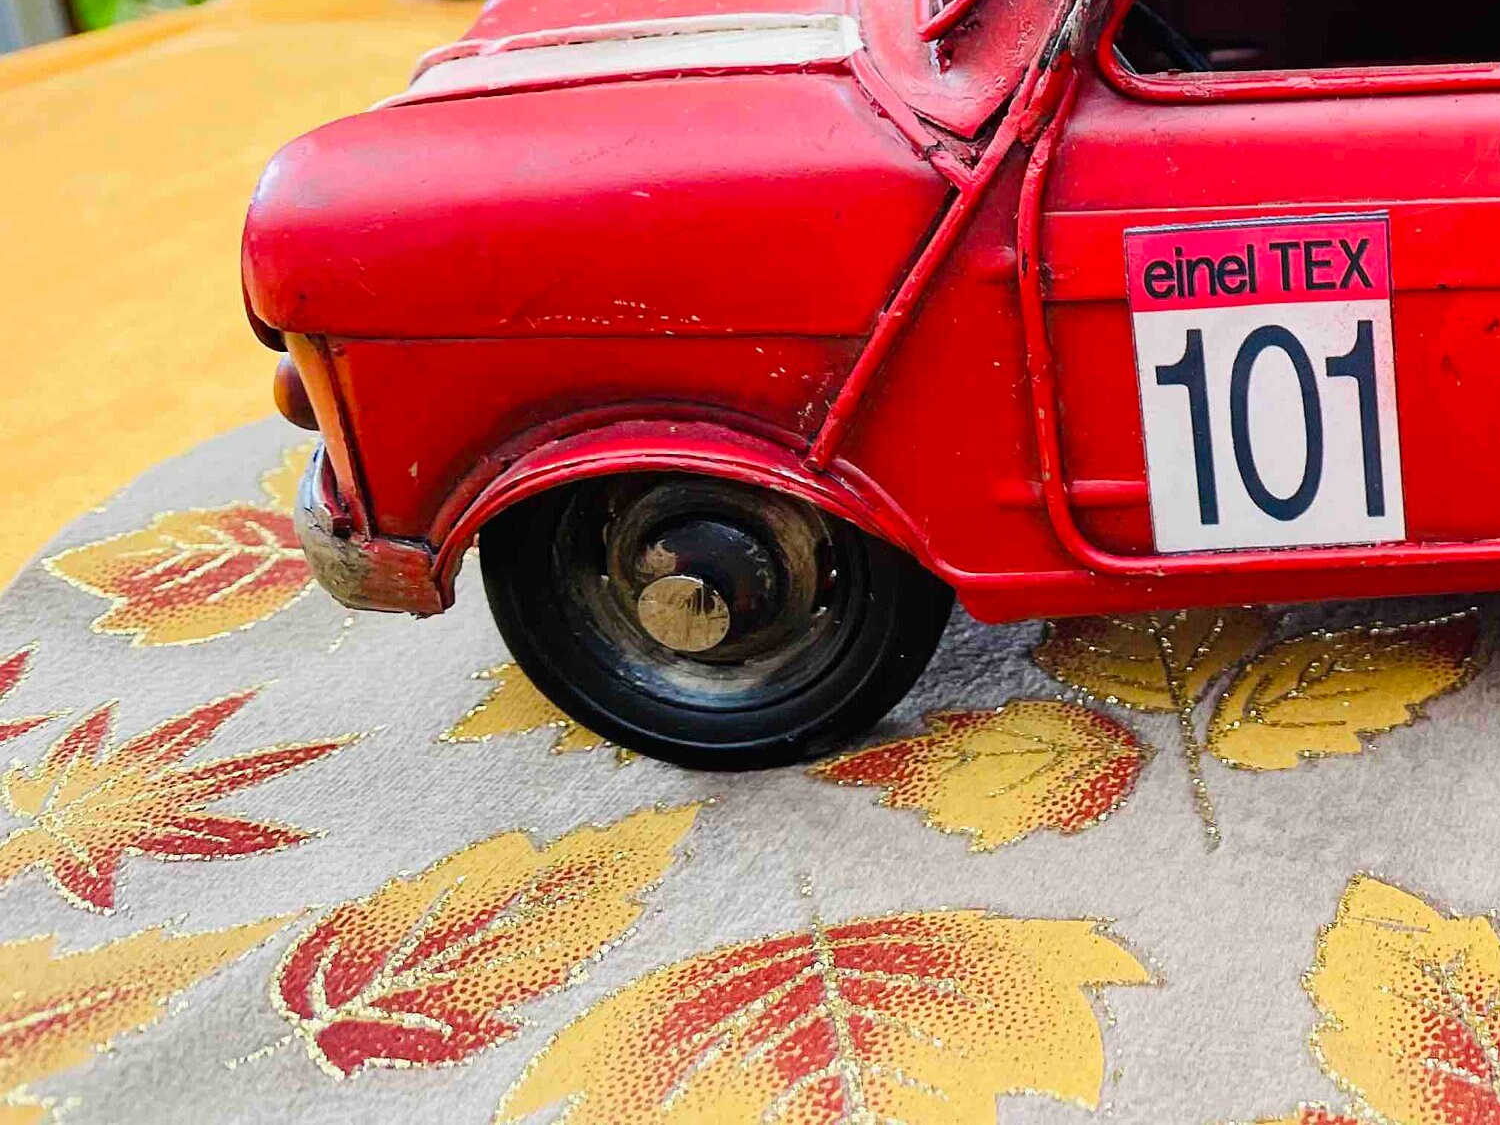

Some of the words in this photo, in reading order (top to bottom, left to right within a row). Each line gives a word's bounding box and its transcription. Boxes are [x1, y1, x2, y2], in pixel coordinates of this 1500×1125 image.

[1144, 244, 1257, 299] einel
[1269, 238, 1374, 292] TEX
[1155, 319, 1386, 525] 101
